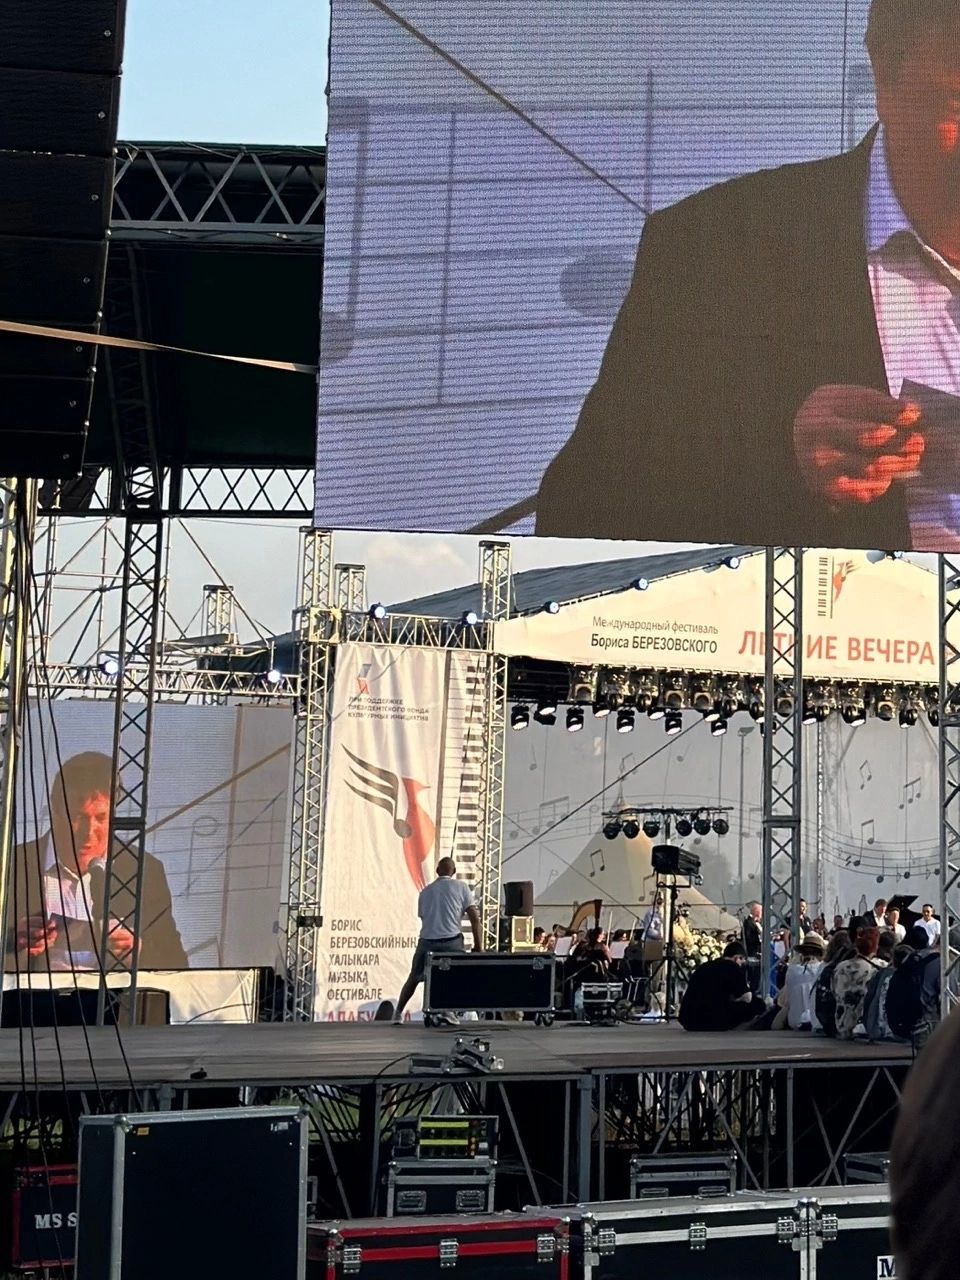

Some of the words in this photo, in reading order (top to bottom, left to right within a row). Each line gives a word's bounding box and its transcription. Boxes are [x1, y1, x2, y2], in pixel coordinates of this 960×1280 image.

[593, 616, 670, 631] Международный
[671, 620, 719, 635] фестиваль
[591, 633, 629, 650] Бориса
[632, 636, 718, 653] БЕРЕЗОВСКОГО
[738, 630, 837, 660] ЛТИЕ
[847, 636, 935, 665] ВЕЧЕРА
[331, 919, 362, 931] БОРИС
[329, 953, 380, 966] ХАЛЫКАРА
[328, 970, 369, 984] МУЗЫКА
[327, 988, 383, 1000] ФЕСТИВАЛЕ
[35, 1213, 62, 1229] MS
